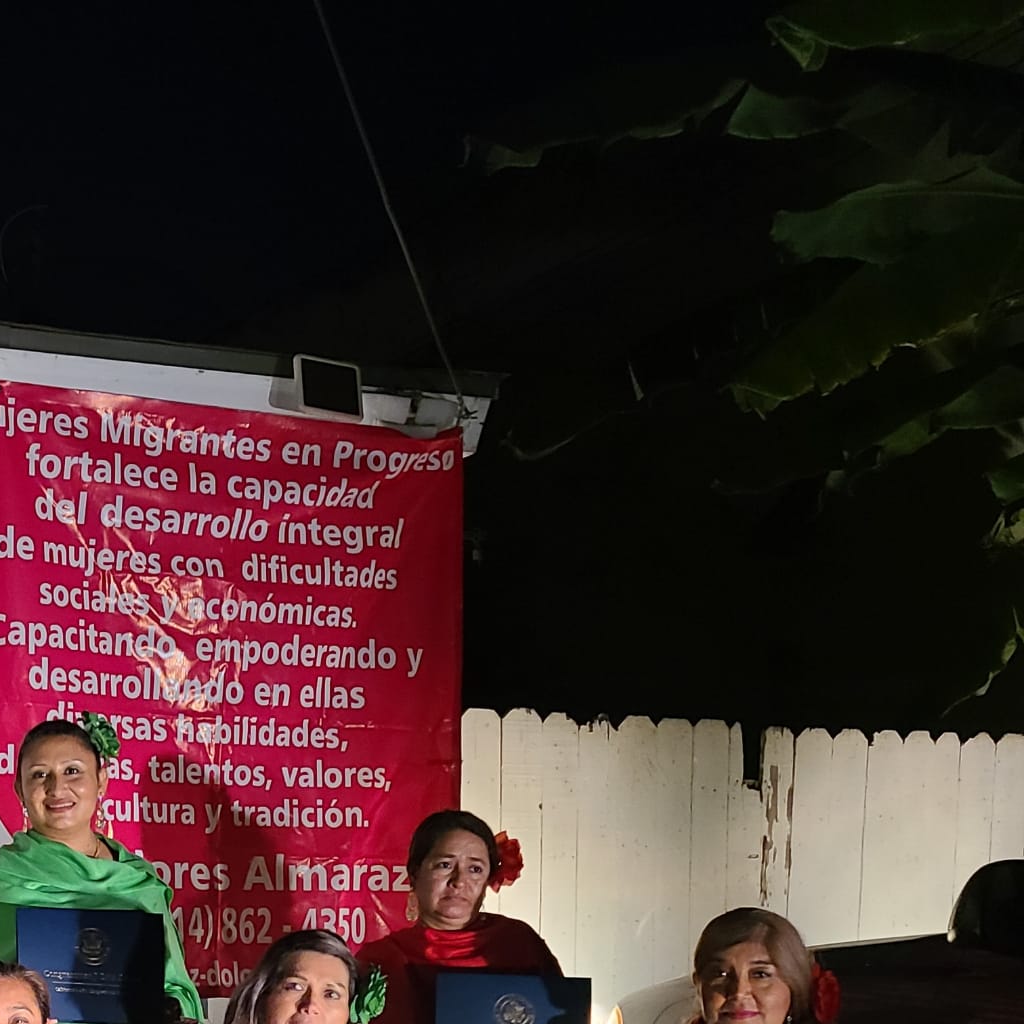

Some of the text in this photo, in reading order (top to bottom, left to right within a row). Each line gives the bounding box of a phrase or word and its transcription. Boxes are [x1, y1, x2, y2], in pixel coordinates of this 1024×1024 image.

[101, 407, 271, 462] Migrantes
[282, 442, 321, 467] en
[332, 440, 455, 479] Progreso
[26, 443, 381, 510] fortalece la capacidad
[35, 491, 86, 526] del
[100, 499, 268, 542] desarrollo
[43, 539, 161, 576] mujeres
[171, 555, 224, 578] con
[242, 554, 398, 590] dificultades
[40, 579, 357, 629] sociales y económicas.
[196, 634, 396, 673] empoderando
[406, 646, 424, 677] y
[28, 658, 365, 709] desarrollando en ellas
[177, 712, 349, 752] habilidades,
[149, 755, 273, 792] talentos,
[282, 759, 393, 793] valores,
[102, 793, 371, 833] cultura y tradición.
[243, 853, 413, 892] Almaraz
[221, 907, 273, 945] 862
[302, 906, 366, 944] 4350
